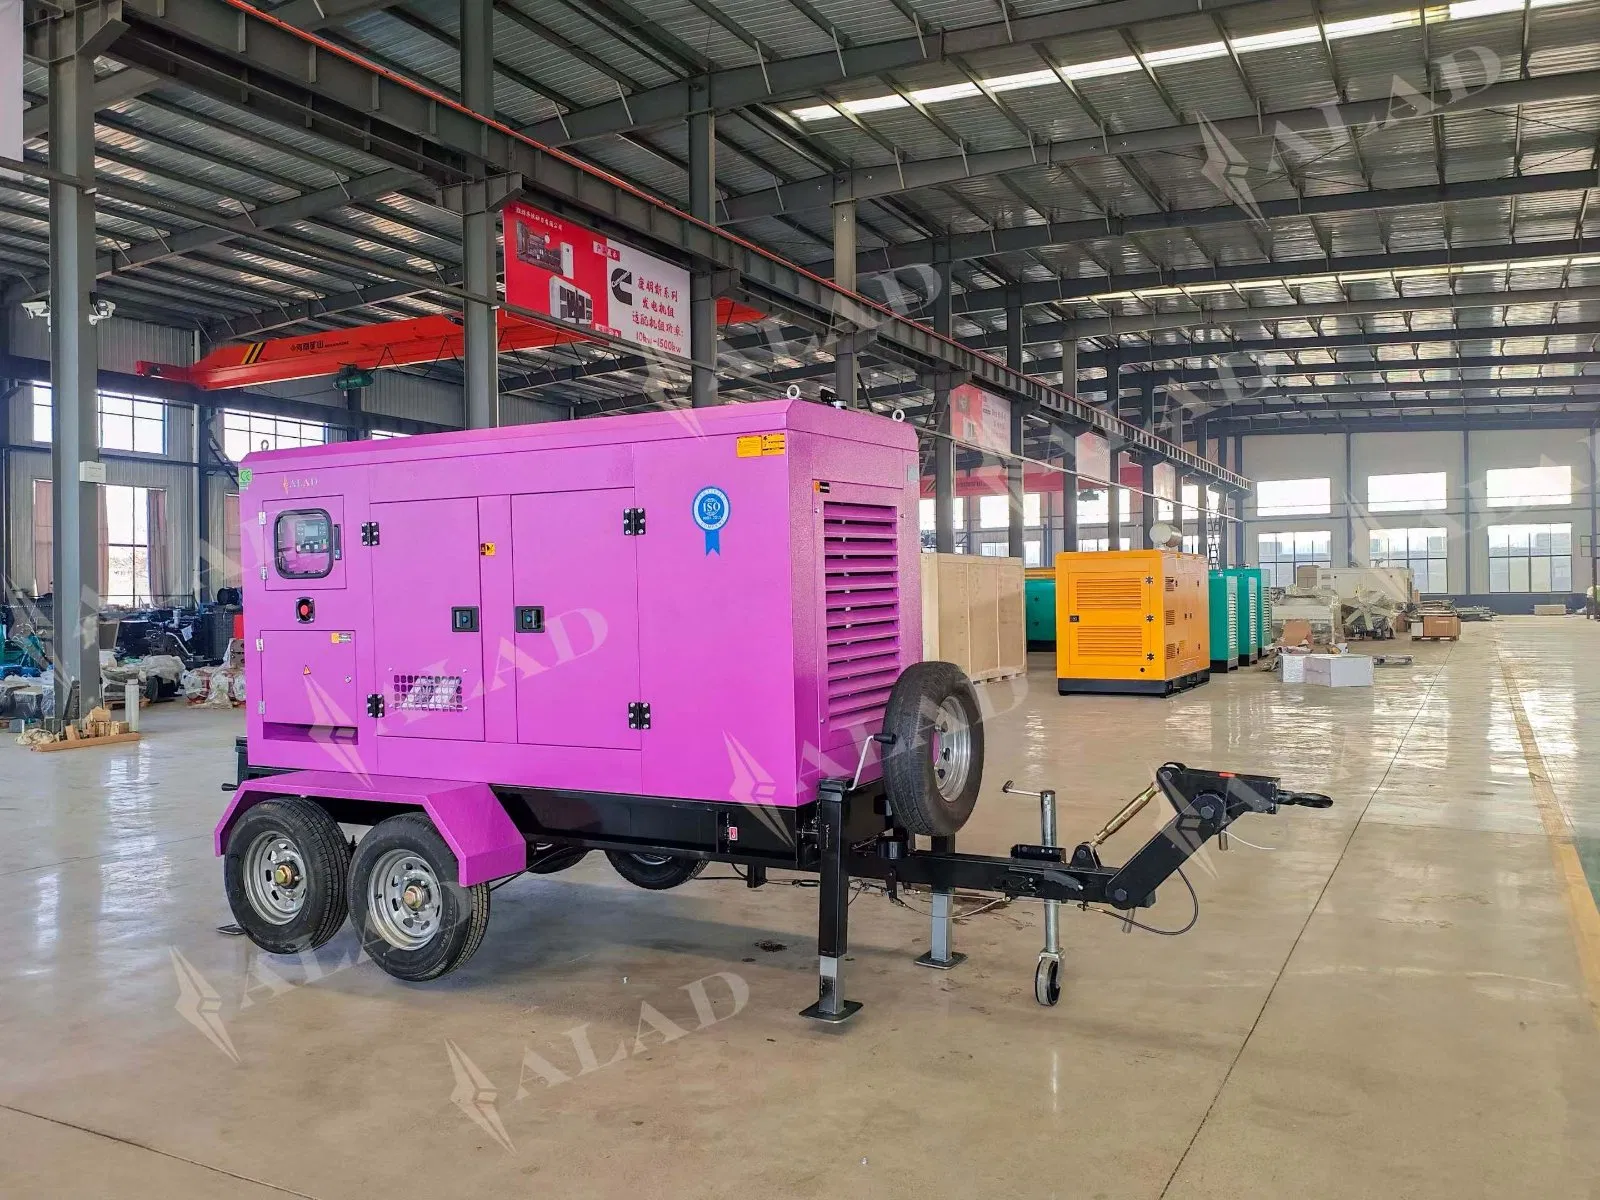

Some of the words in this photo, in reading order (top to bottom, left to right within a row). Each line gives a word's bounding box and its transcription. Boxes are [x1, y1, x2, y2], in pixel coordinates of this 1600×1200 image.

[637, 276, 678, 303] 康明斯系列
[642, 296, 675, 318] 发电机组
[289, 477, 318, 489] ALAD
[702, 502, 721, 512] ISO
